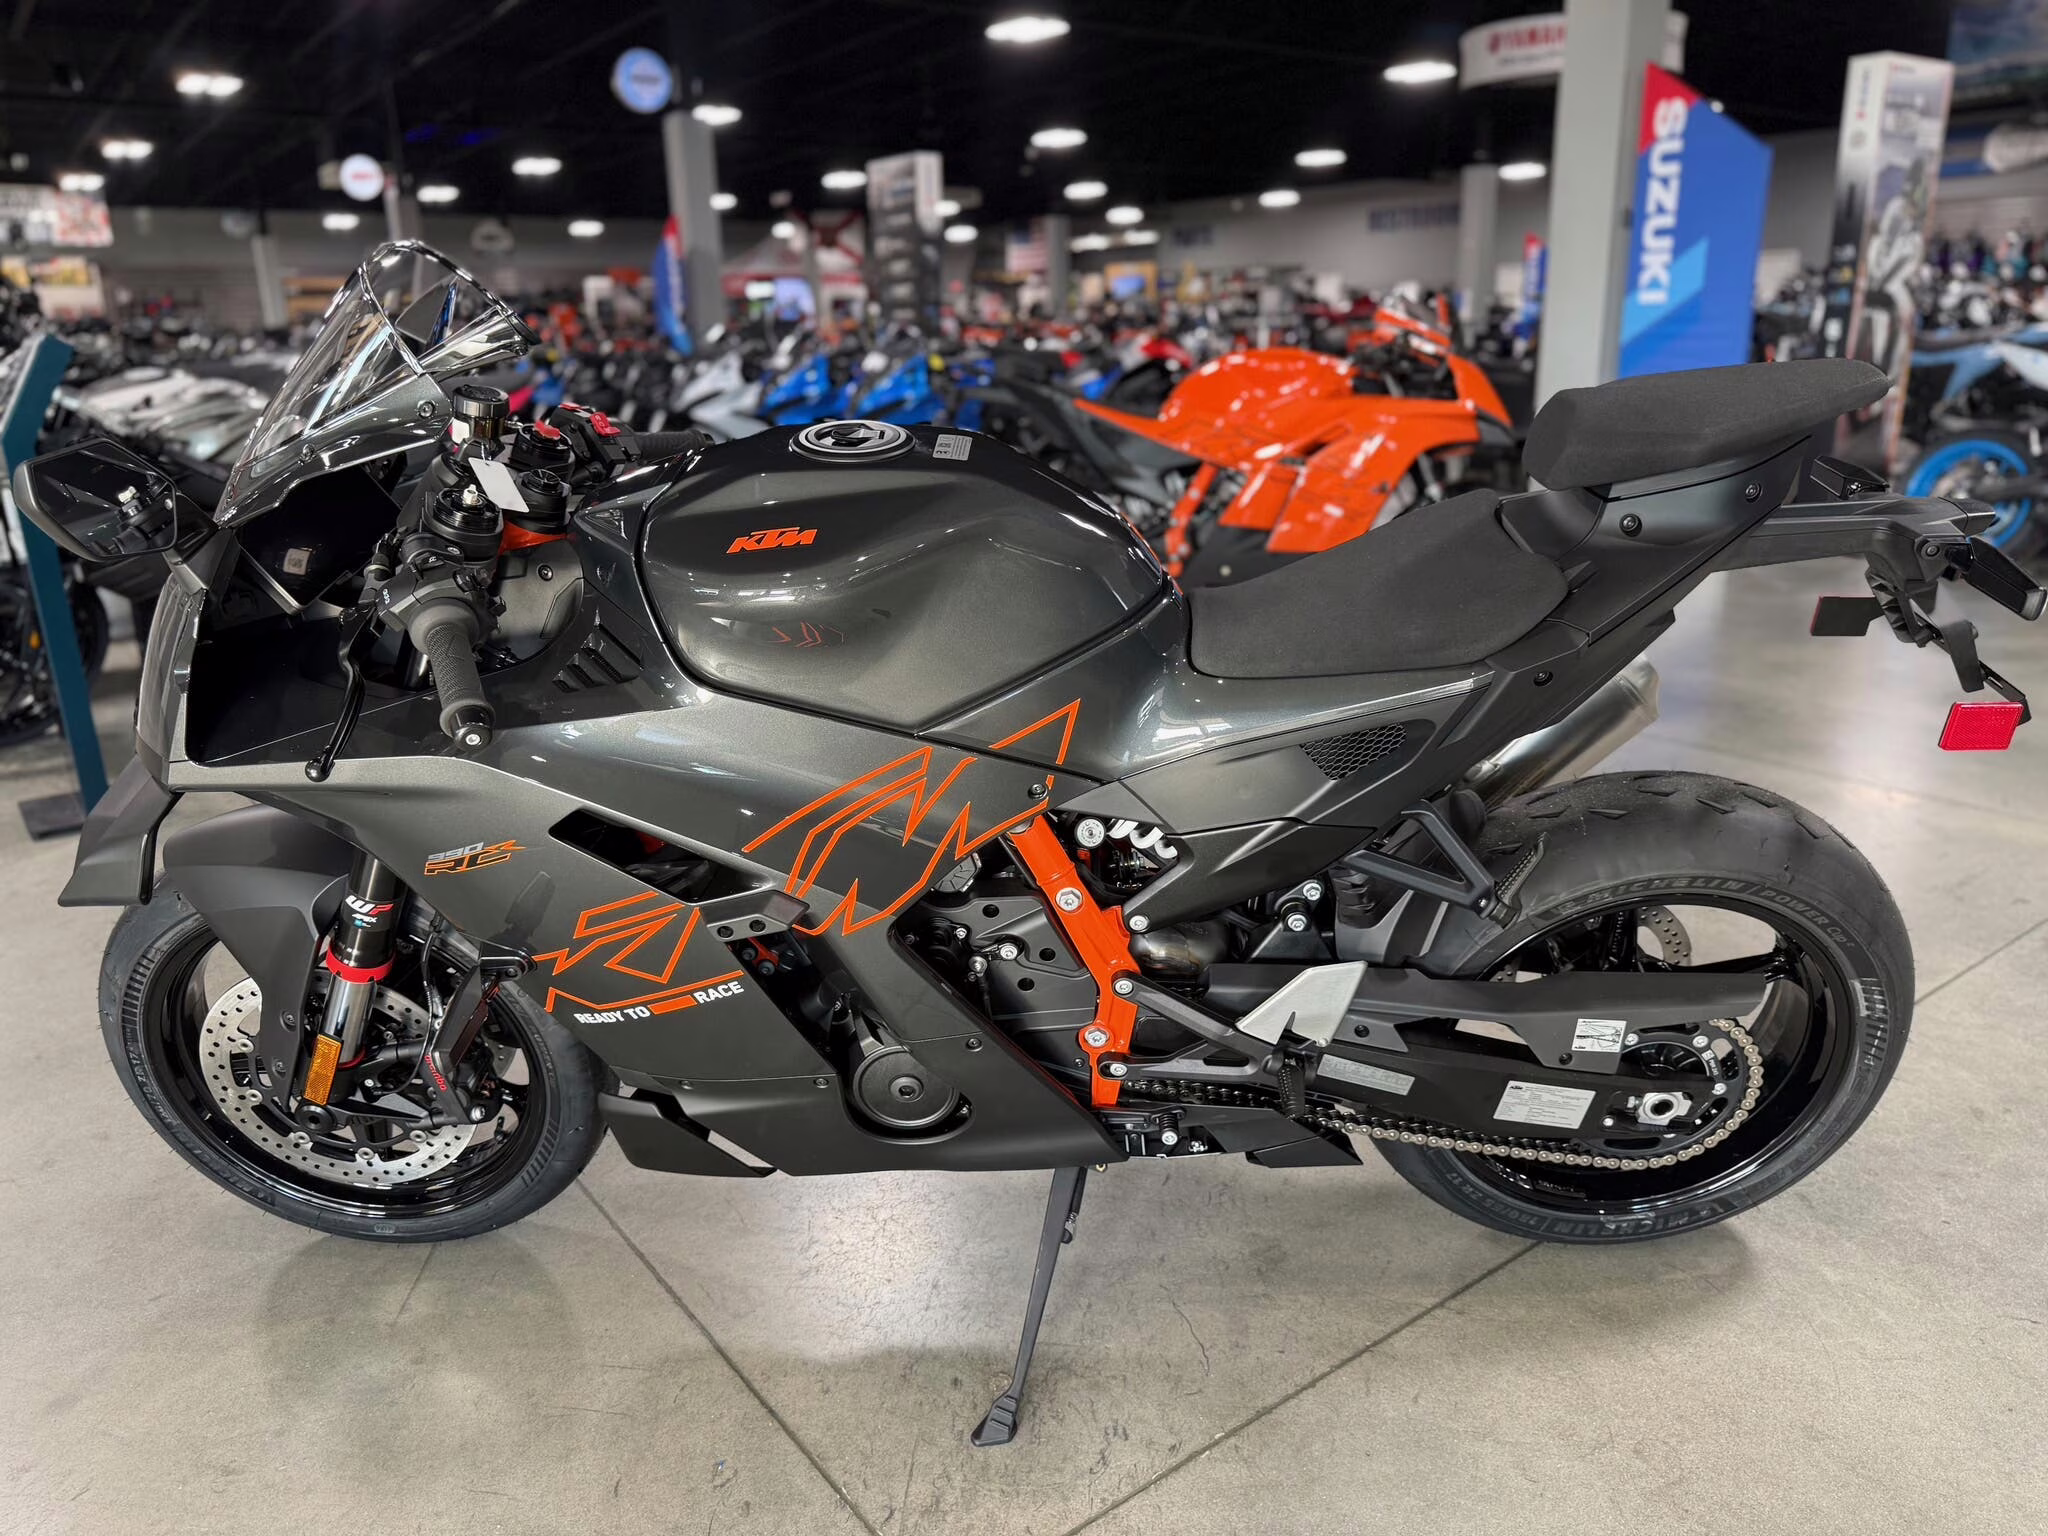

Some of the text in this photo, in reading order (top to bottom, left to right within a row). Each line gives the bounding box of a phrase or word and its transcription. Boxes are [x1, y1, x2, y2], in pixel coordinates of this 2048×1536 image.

[1637, 96, 1688, 305] SUZUKI
[726, 527, 817, 554] KTM
[428, 842, 484, 861] 990
[345, 895, 394, 916] WP
[1587, 875, 1743, 903] MICHELIN
[1761, 889, 1830, 928] POWER
[574, 981, 745, 1024] READY TO RACE
